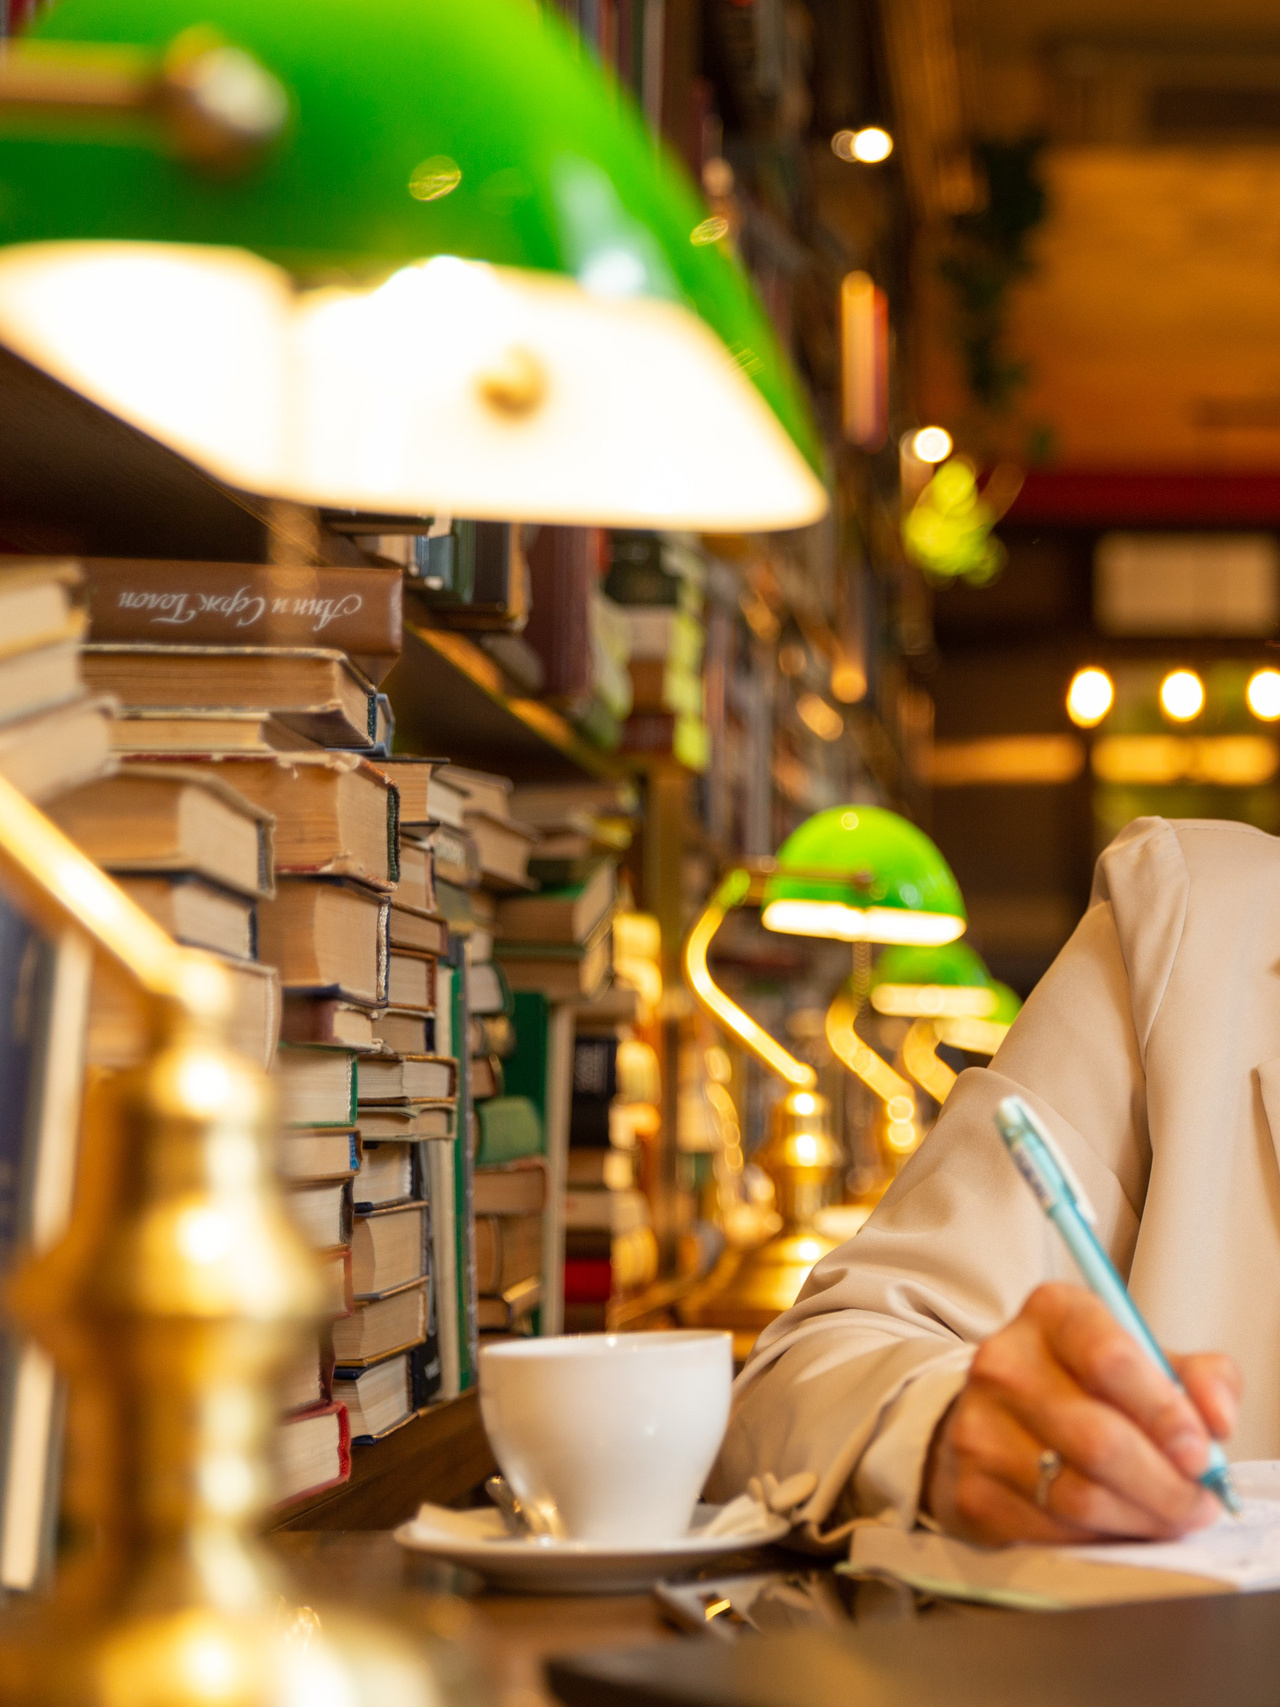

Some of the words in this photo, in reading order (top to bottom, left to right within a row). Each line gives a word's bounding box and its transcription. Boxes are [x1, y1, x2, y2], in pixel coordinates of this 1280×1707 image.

[199, 585, 266, 627] Серж
[271, 597, 292, 615] и
[293, 594, 363, 631] Анн
